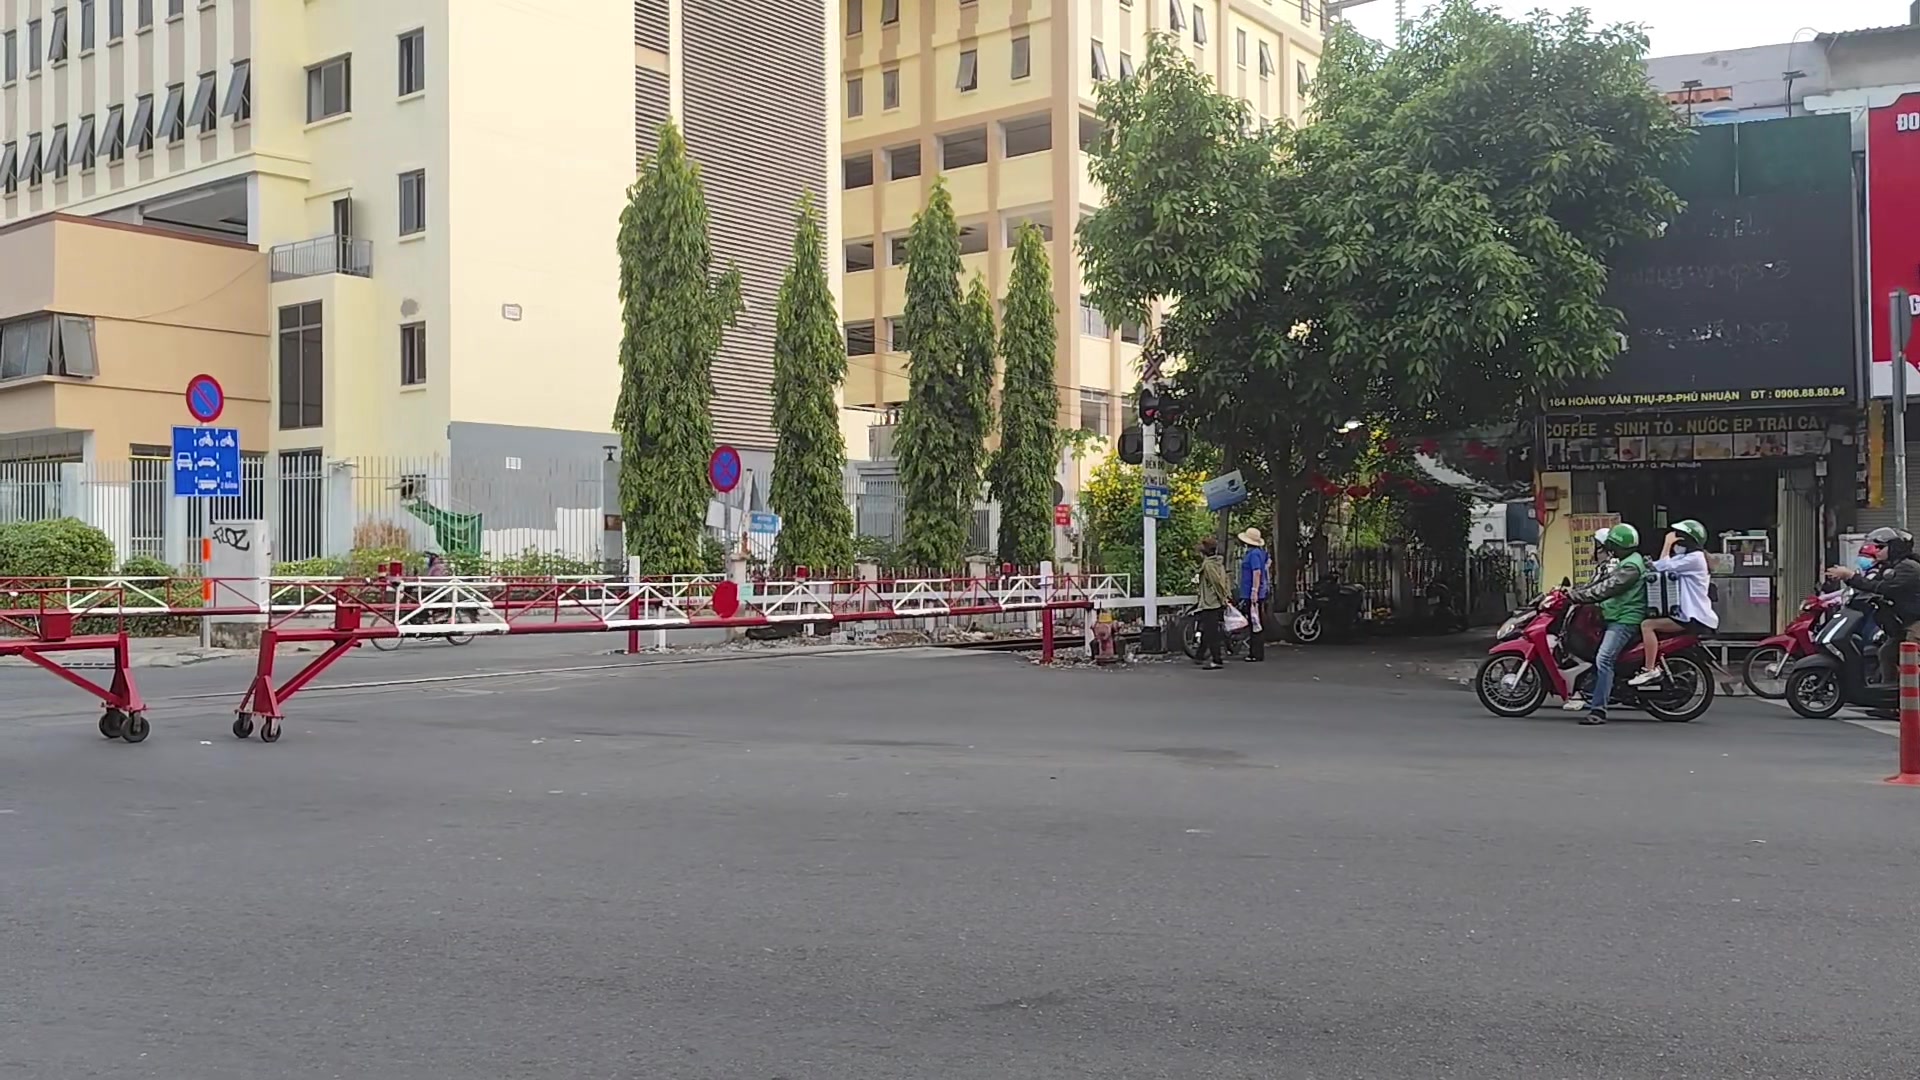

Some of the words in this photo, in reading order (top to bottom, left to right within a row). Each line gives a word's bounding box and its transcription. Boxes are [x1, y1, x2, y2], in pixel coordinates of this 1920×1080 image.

[1549, 397, 1566, 407] 164
[1568, 394, 1606, 406] HOÀNG
[1609, 393, 1631, 405] VĂN
[1701, 391, 1740, 402] NHUẬN
[1751, 390, 1766, 399] ĐT
[1774, 387, 1846, 398] 0906.88.80.84
[1614, 421, 1649, 436] SINH
[1687, 416, 1729, 433] NƯỚC
[1757, 414, 1792, 431] TRÁI
